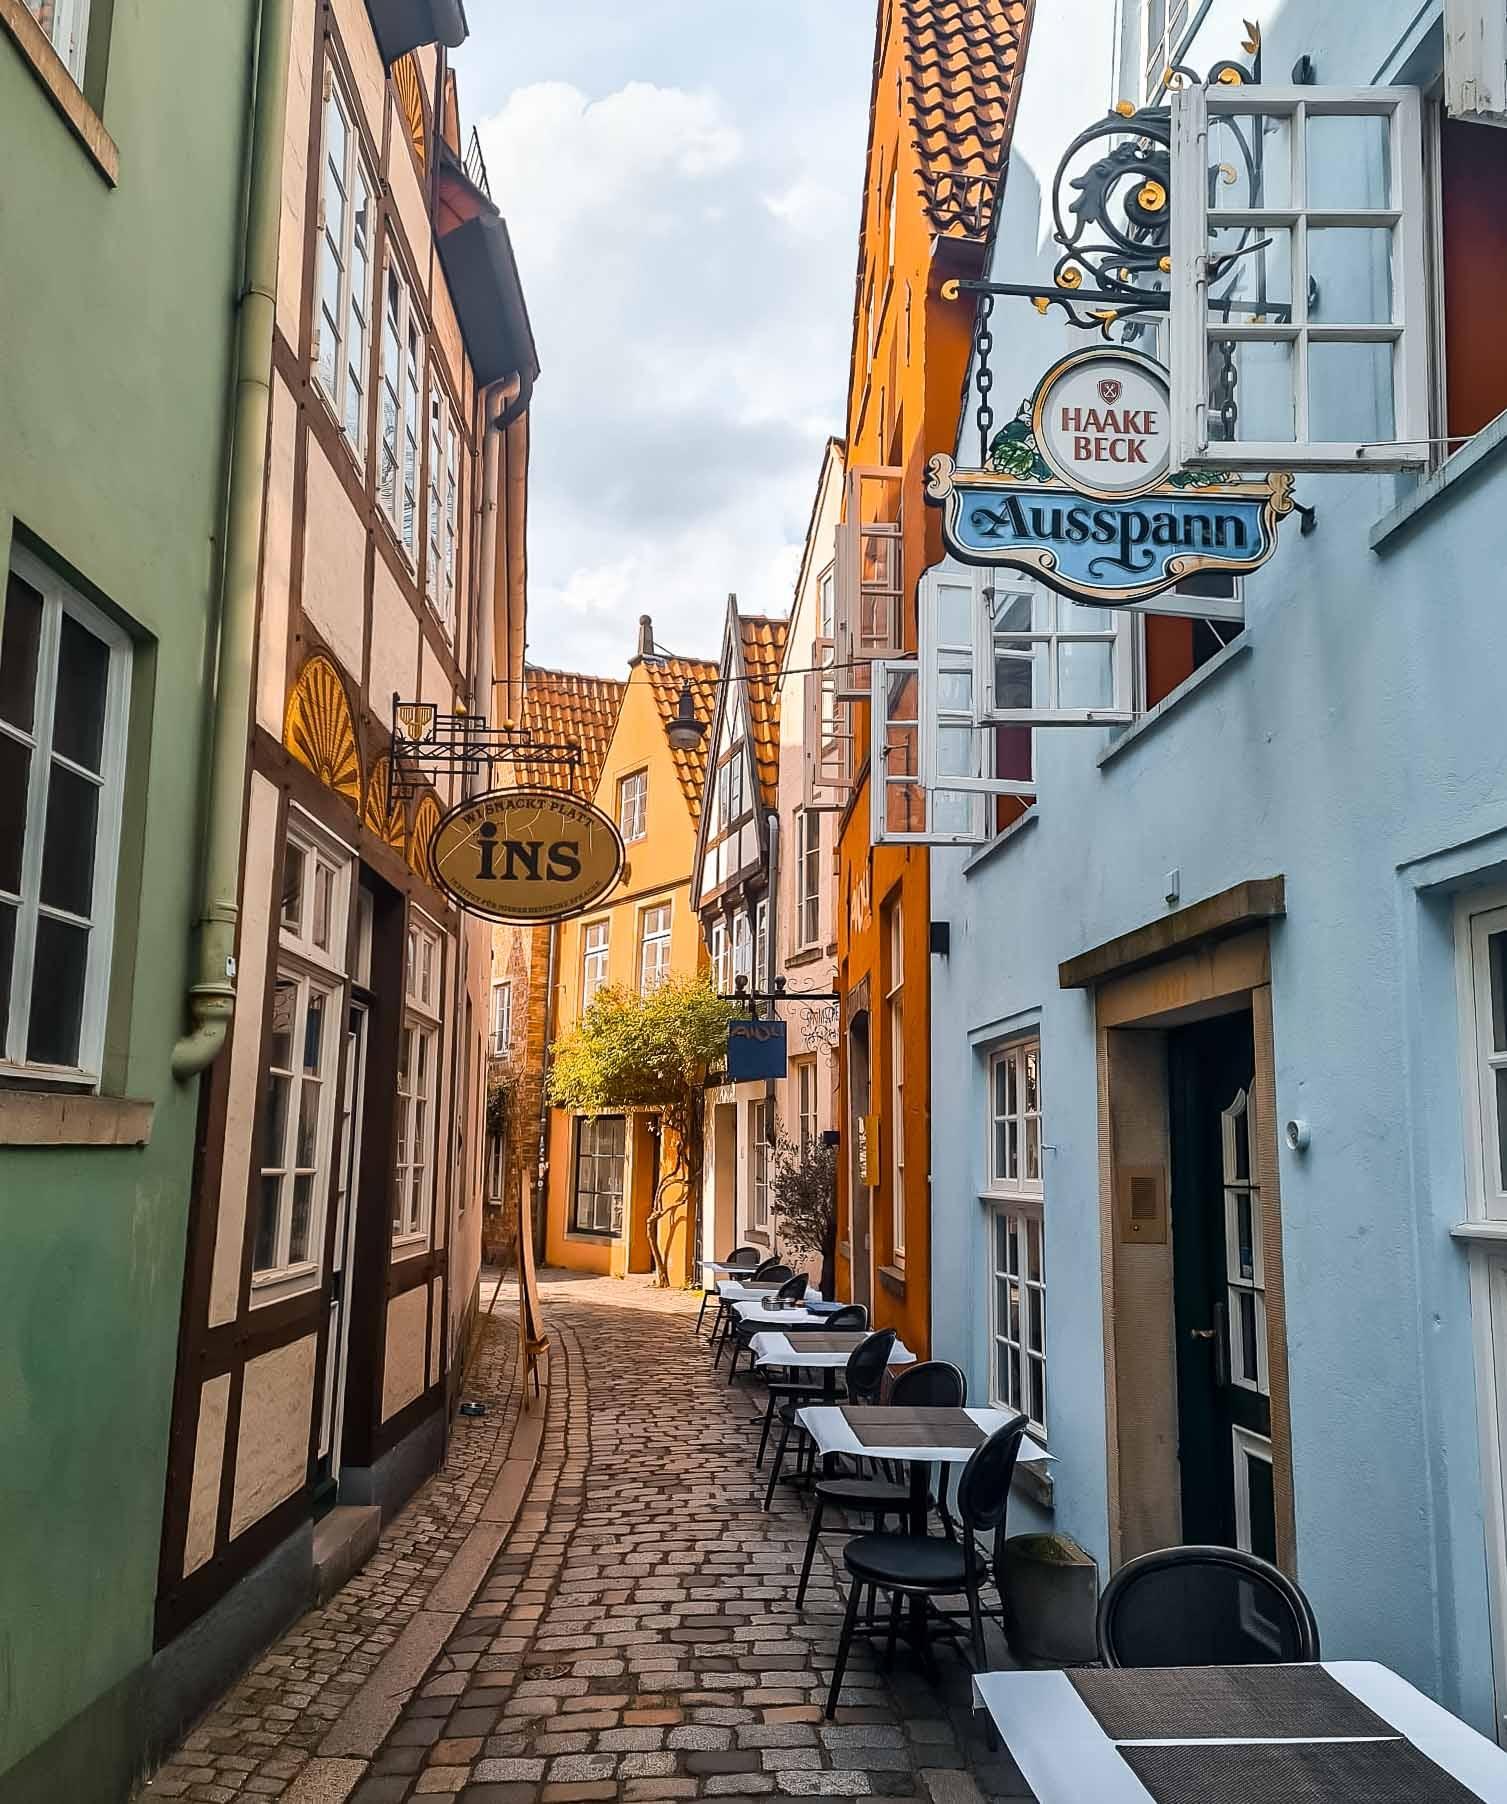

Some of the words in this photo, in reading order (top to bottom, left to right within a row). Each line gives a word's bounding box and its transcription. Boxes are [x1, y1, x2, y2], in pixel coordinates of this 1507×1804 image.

[1061, 407, 1159, 435] HAAKE
[1073, 436, 1149, 463] BECK
[970, 494, 1248, 578] Ausspann
[549, 801, 594, 826] PLATT
